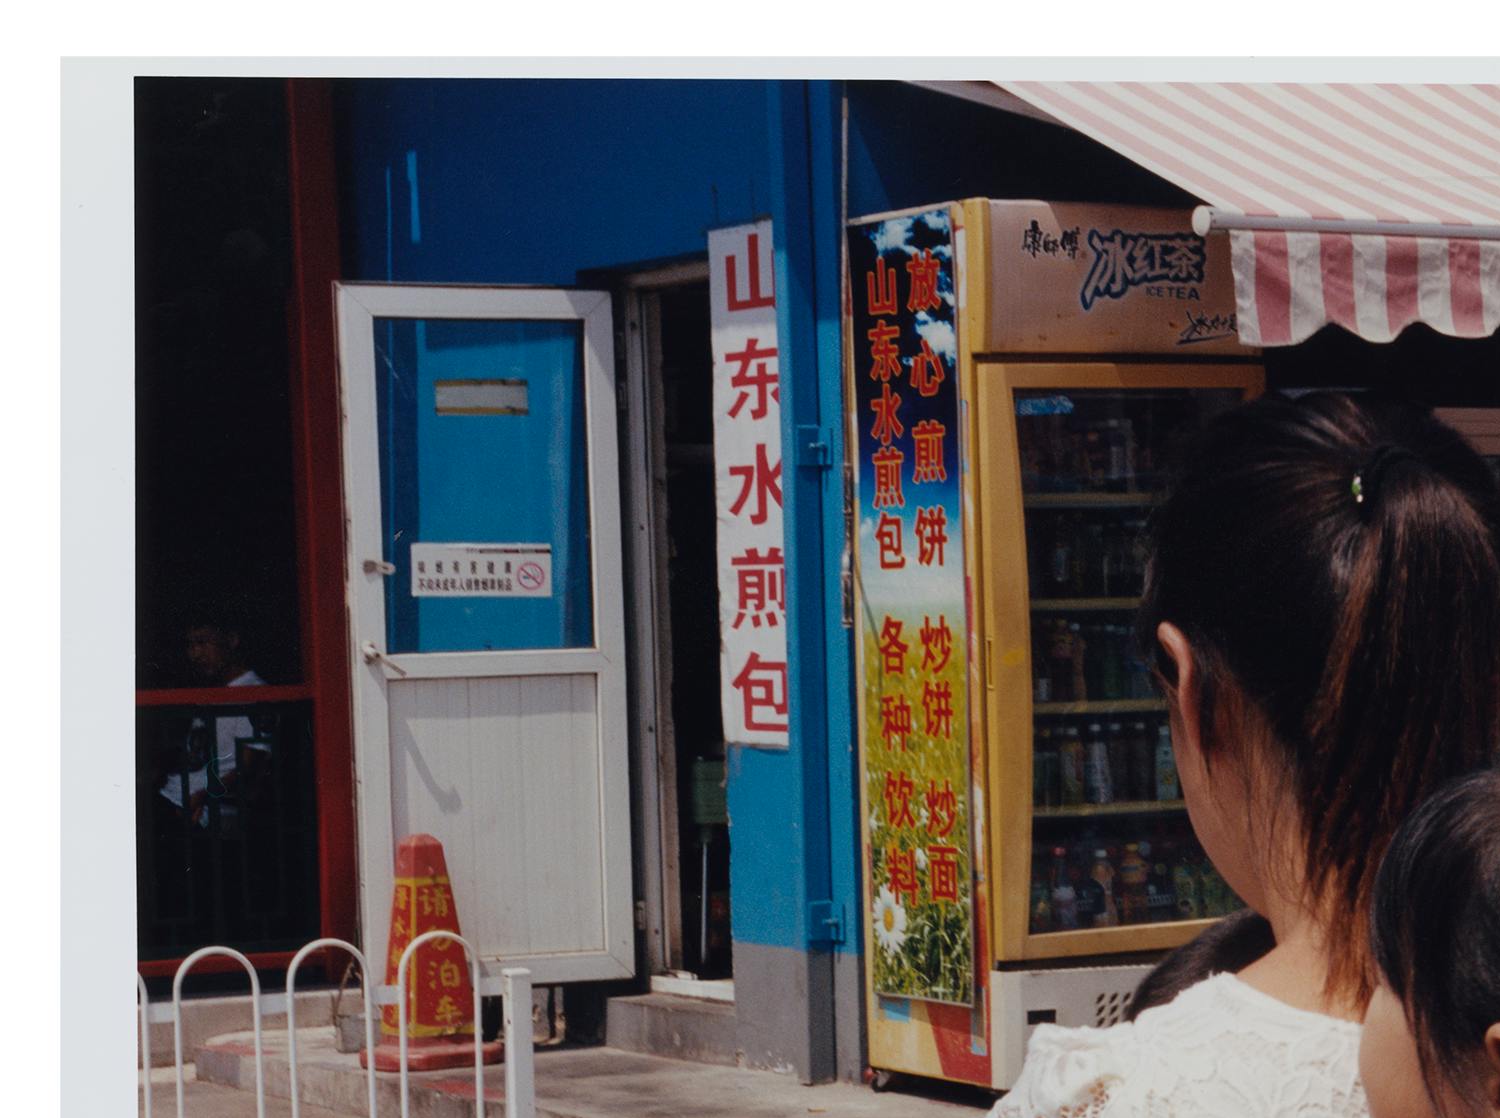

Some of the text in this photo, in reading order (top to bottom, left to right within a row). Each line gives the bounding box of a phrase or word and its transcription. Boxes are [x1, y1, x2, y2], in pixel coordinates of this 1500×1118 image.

[725, 233, 787, 731] 山东水煎包
[1080, 228, 1206, 310] 冰红茶
[1145, 285, 1200, 300] ICE TEA
[866, 257, 918, 906] 山东水煎包 各种饮料
[907, 248, 958, 903] 放心煎饼 炒饼 炒面
